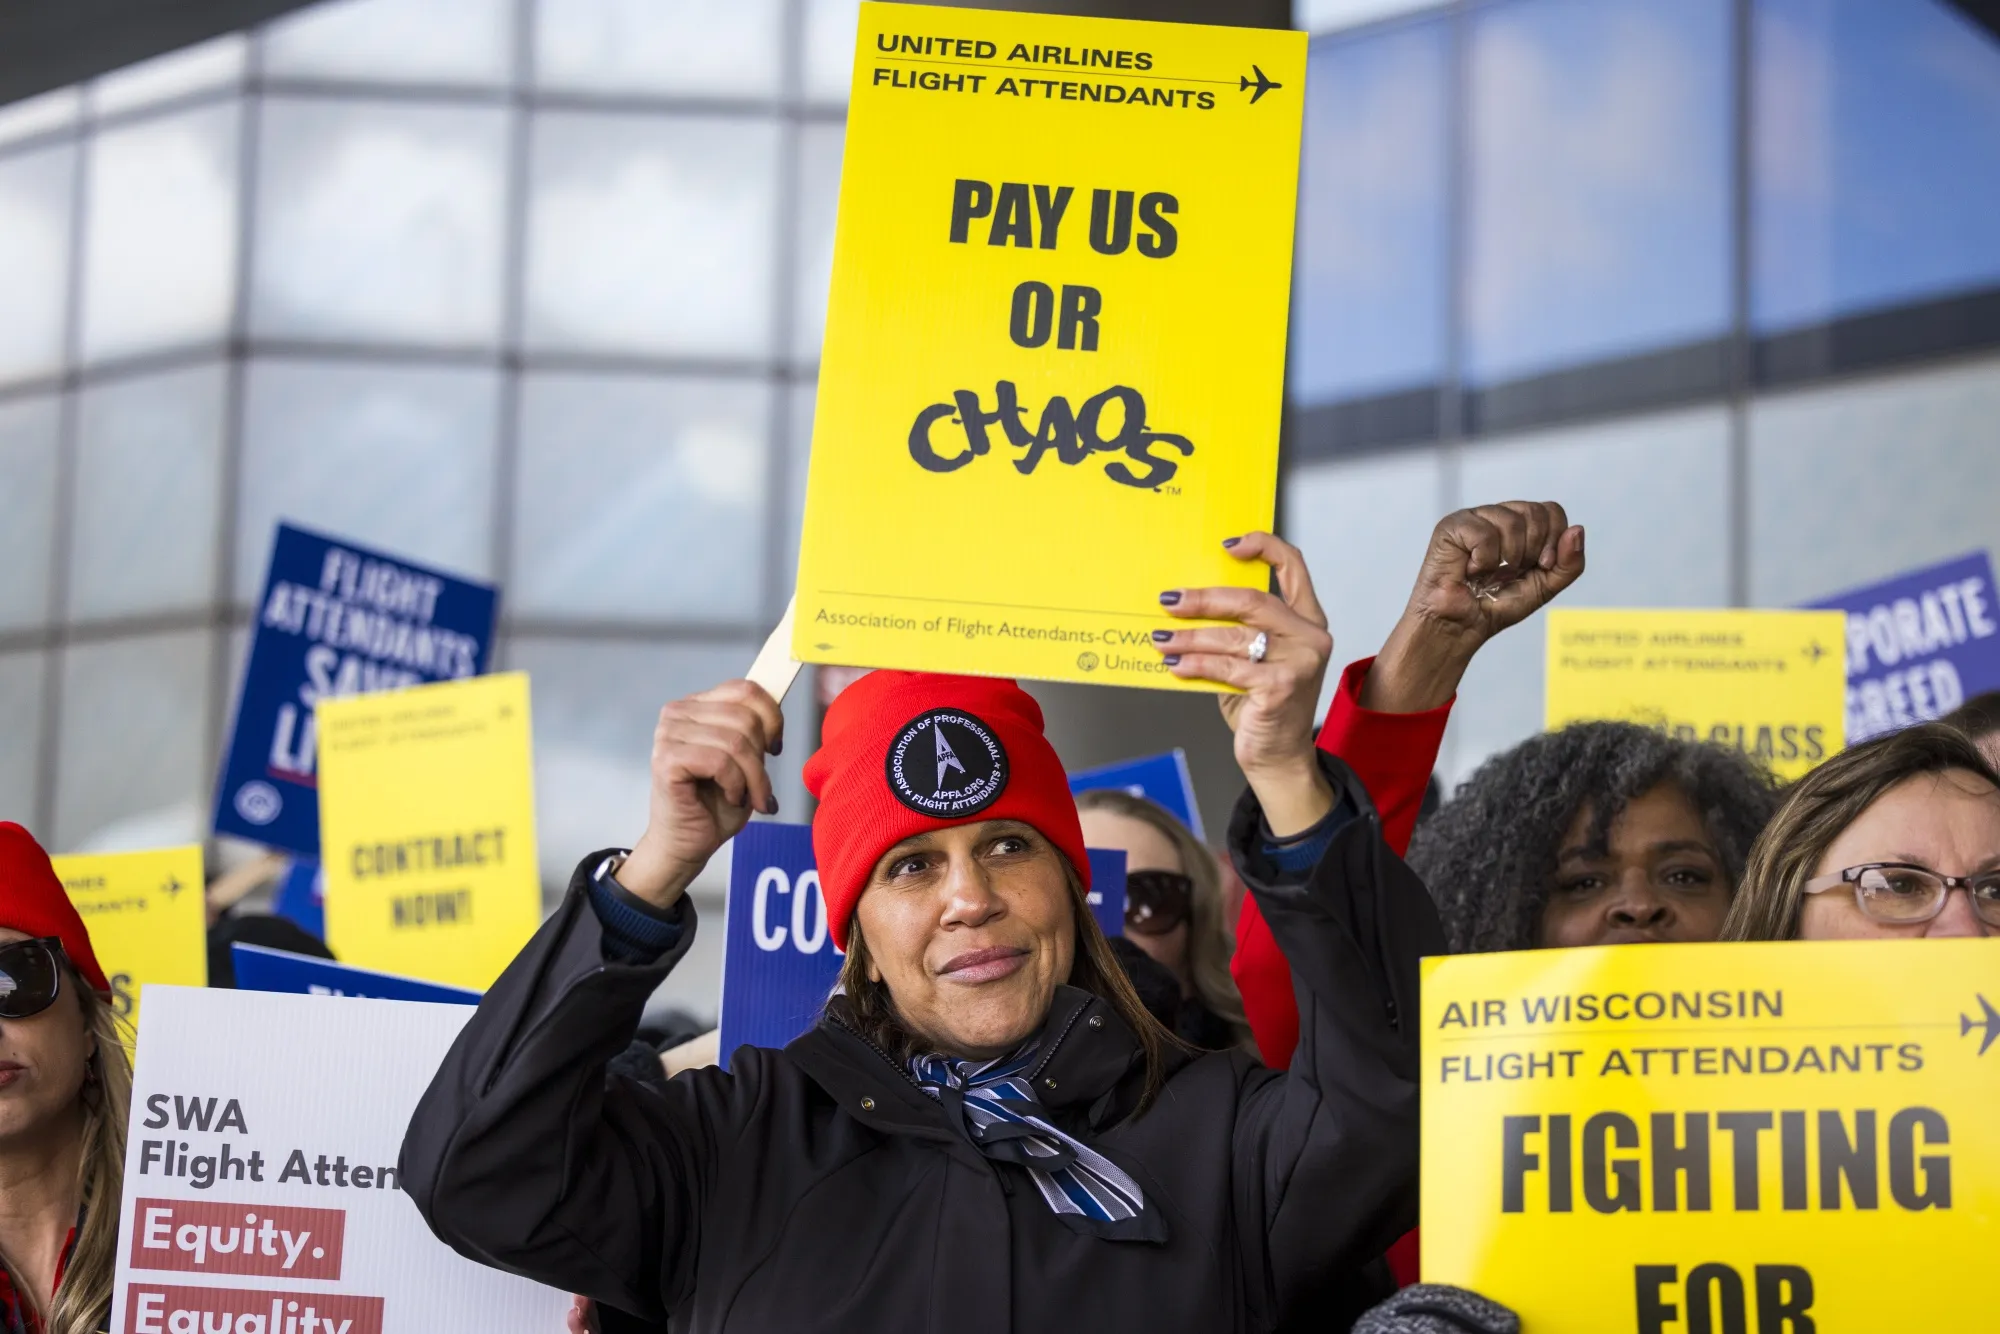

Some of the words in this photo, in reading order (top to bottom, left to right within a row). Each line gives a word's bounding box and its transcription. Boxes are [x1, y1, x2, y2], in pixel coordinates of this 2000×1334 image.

[876, 33, 997, 60] UNITED
[1007, 43, 1153, 71] AIRLINES
[873, 68, 986, 94] FLIGHT
[995, 78, 1216, 110] ATTENDANTS
[949, 178, 1074, 251] PAY
[1089, 188, 1179, 259] US
[1009, 280, 1102, 352] OR
[908, 380, 1194, 493] CHAOS
[319, 547, 445, 624] FLIGHT
[815, 608, 917, 631] Association
[923, 616, 943, 632] of
[947, 617, 993, 639] Flight
[1846, 576, 1997, 677] PORATE
[893, 729, 918, 790] ASSOCIATION
[917, 718, 932, 730] OF
[933, 714, 1001, 761] PROFESSIONAL
[911, 793, 950, 811] FLIGHT
[951, 769, 1001, 811] ATTENDANTS
[932, 777, 986, 800] APFA.ORG
[1438, 999, 1508, 1029] AIR
[1522, 989, 1784, 1025] WISCONSIN
[1440, 1050, 1583, 1084] FLIGHT
[1600, 1043, 1925, 1077] ATTENDANTS
[142, 1093, 248, 1135] SWA
[139, 1139, 265, 1190] Flight
[1501, 1106, 1953, 1215] FIGHTING
[142, 1206, 325, 1269] Equity.
[1634, 1262, 1817, 1334] FOR
